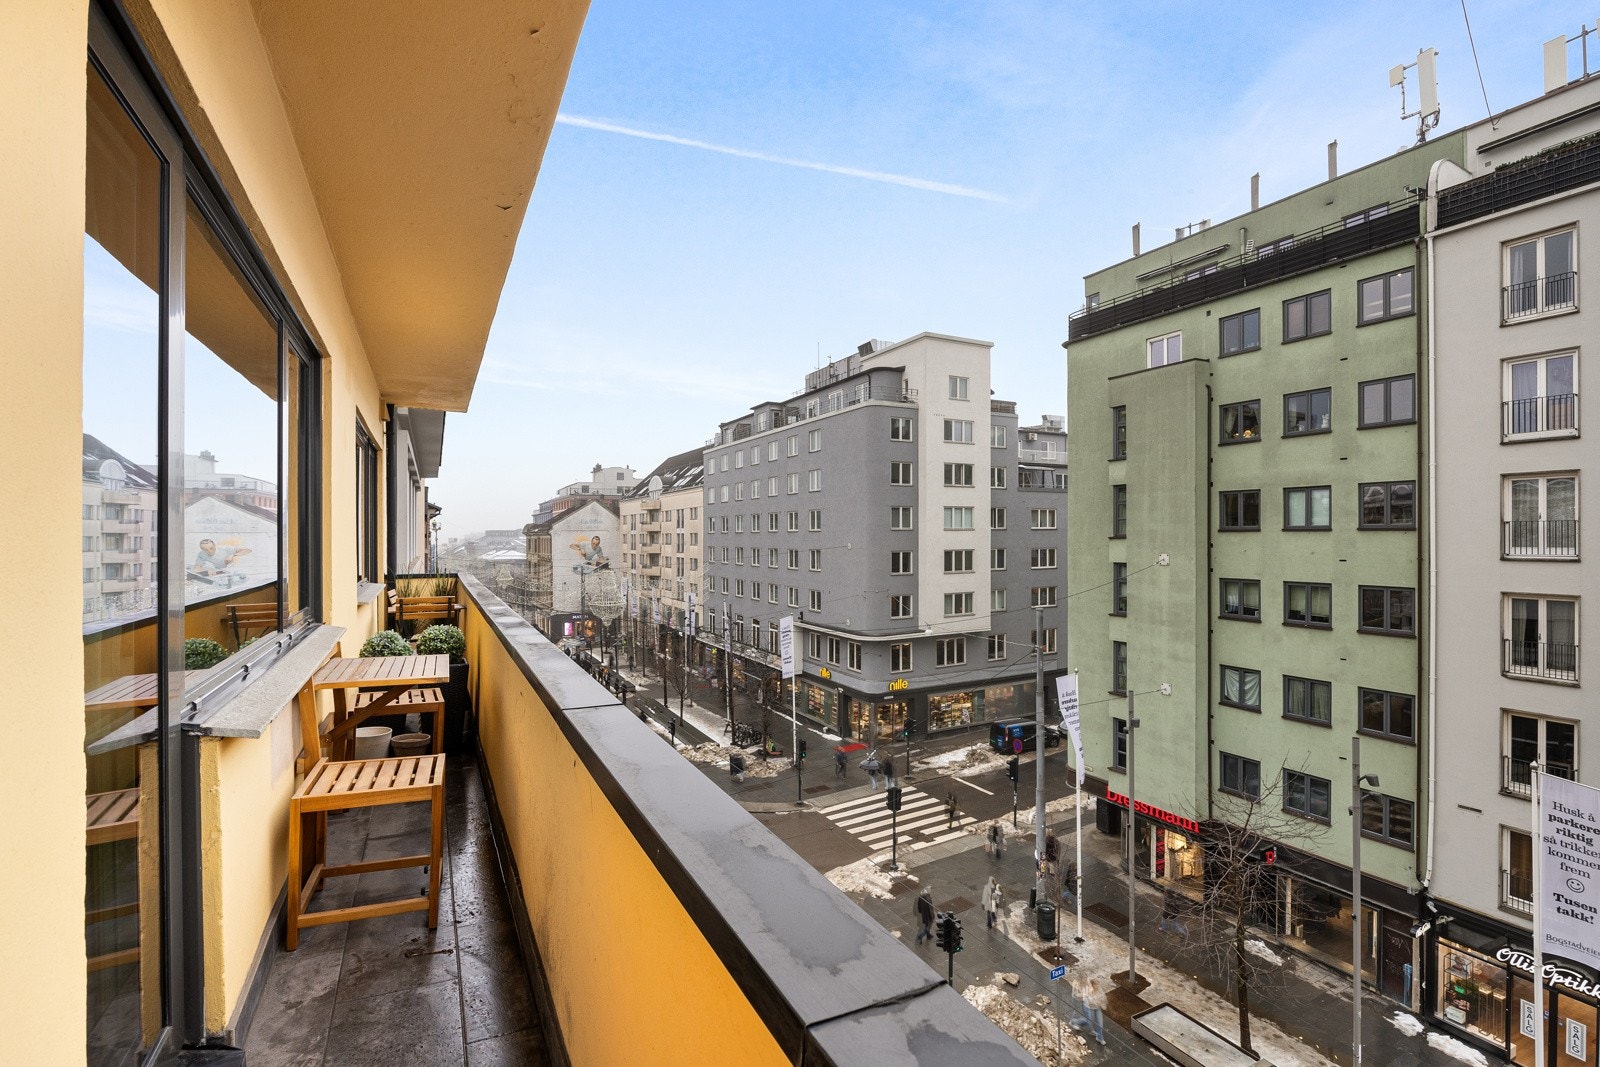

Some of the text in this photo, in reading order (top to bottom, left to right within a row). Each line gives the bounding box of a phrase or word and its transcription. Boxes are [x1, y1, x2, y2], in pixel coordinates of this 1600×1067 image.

[889, 678, 909, 691] nille
[1552, 801, 1596, 822] Husk å
[1543, 836, 1557, 845] så
[1556, 827, 1594, 847] riktig
[1560, 862, 1591, 879] frem
[1553, 892, 1598, 914] Tusen
[1556, 906, 1594, 924] takk!
[1052, 967, 1064, 978] Taxi
[1525, 1006, 1534, 1033] SALG
[1571, 1025, 1580, 1053] SALG
